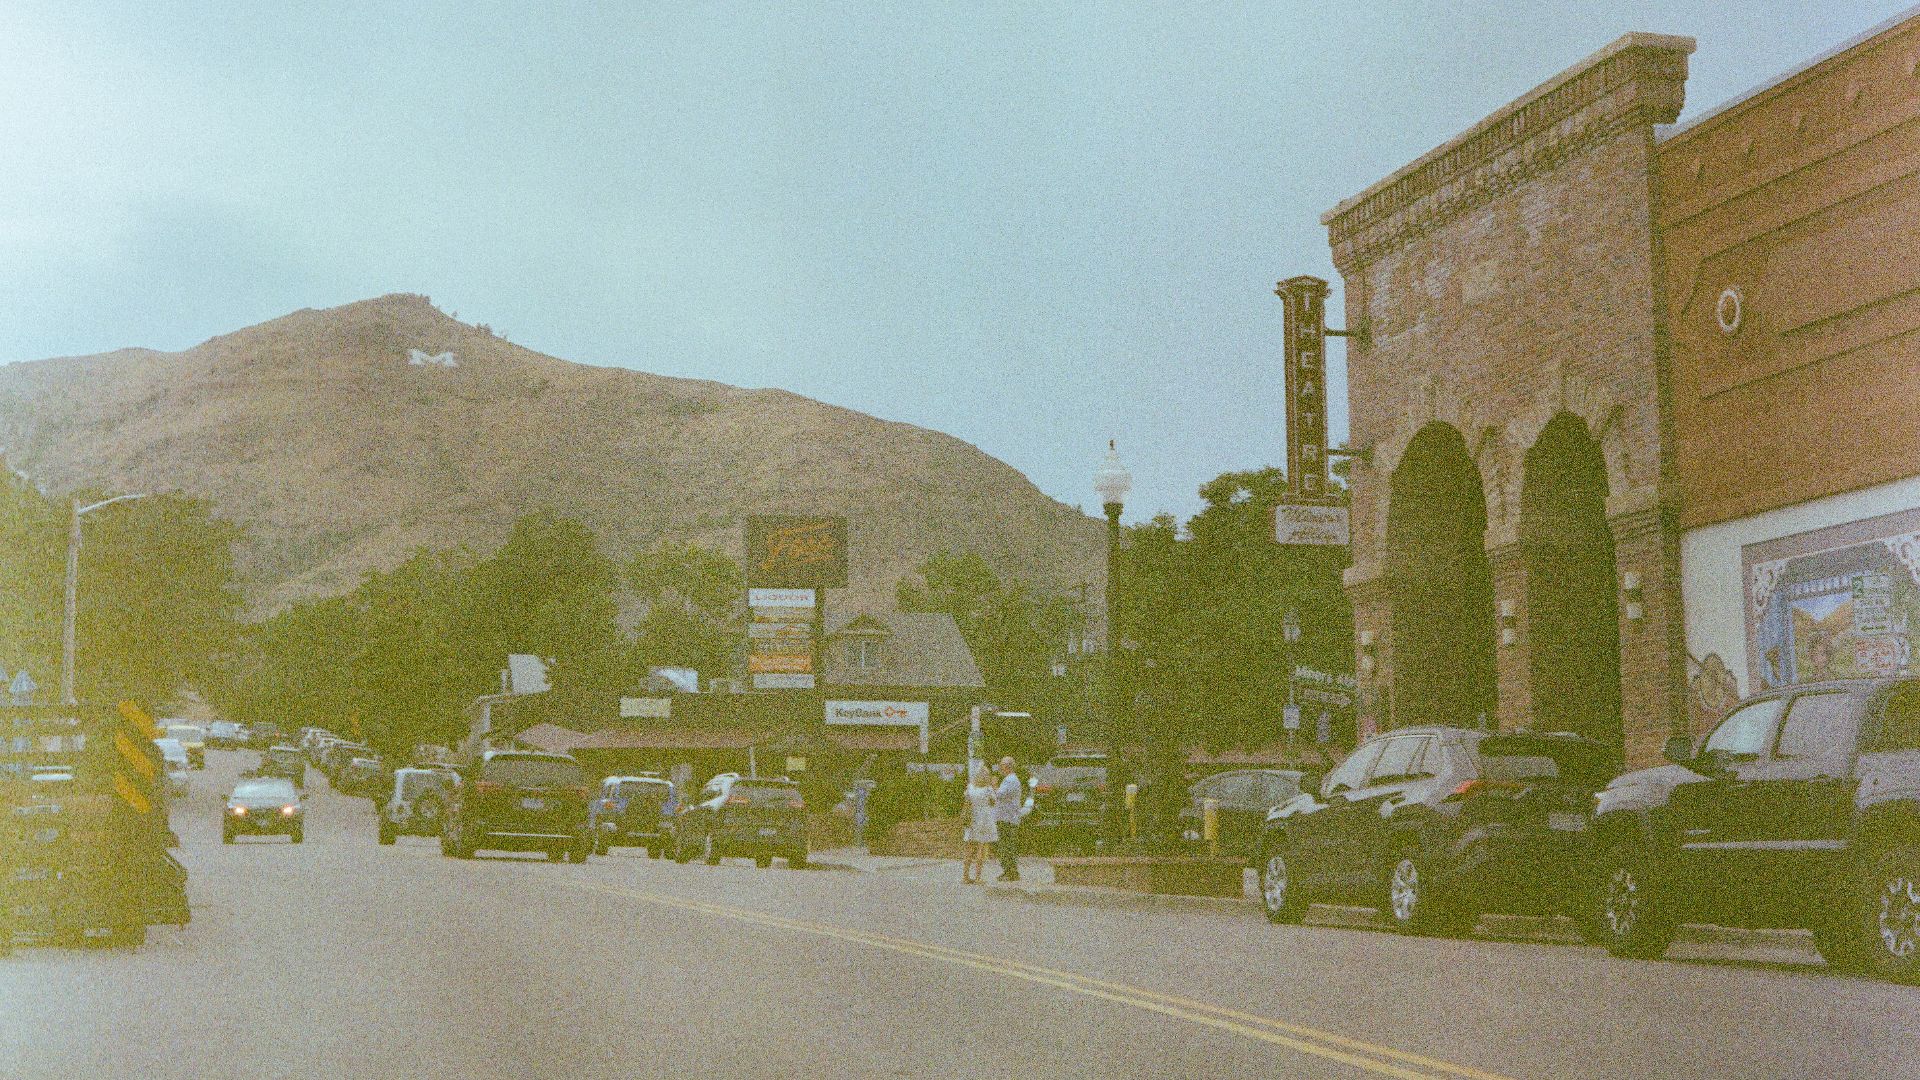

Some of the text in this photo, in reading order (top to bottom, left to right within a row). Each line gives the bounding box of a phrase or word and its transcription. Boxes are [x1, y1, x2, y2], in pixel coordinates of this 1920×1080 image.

[1300, 292, 1318, 492] THEATRE
[755, 593, 809, 602] LIQUOR
[835, 708, 882, 719] KeyBank
